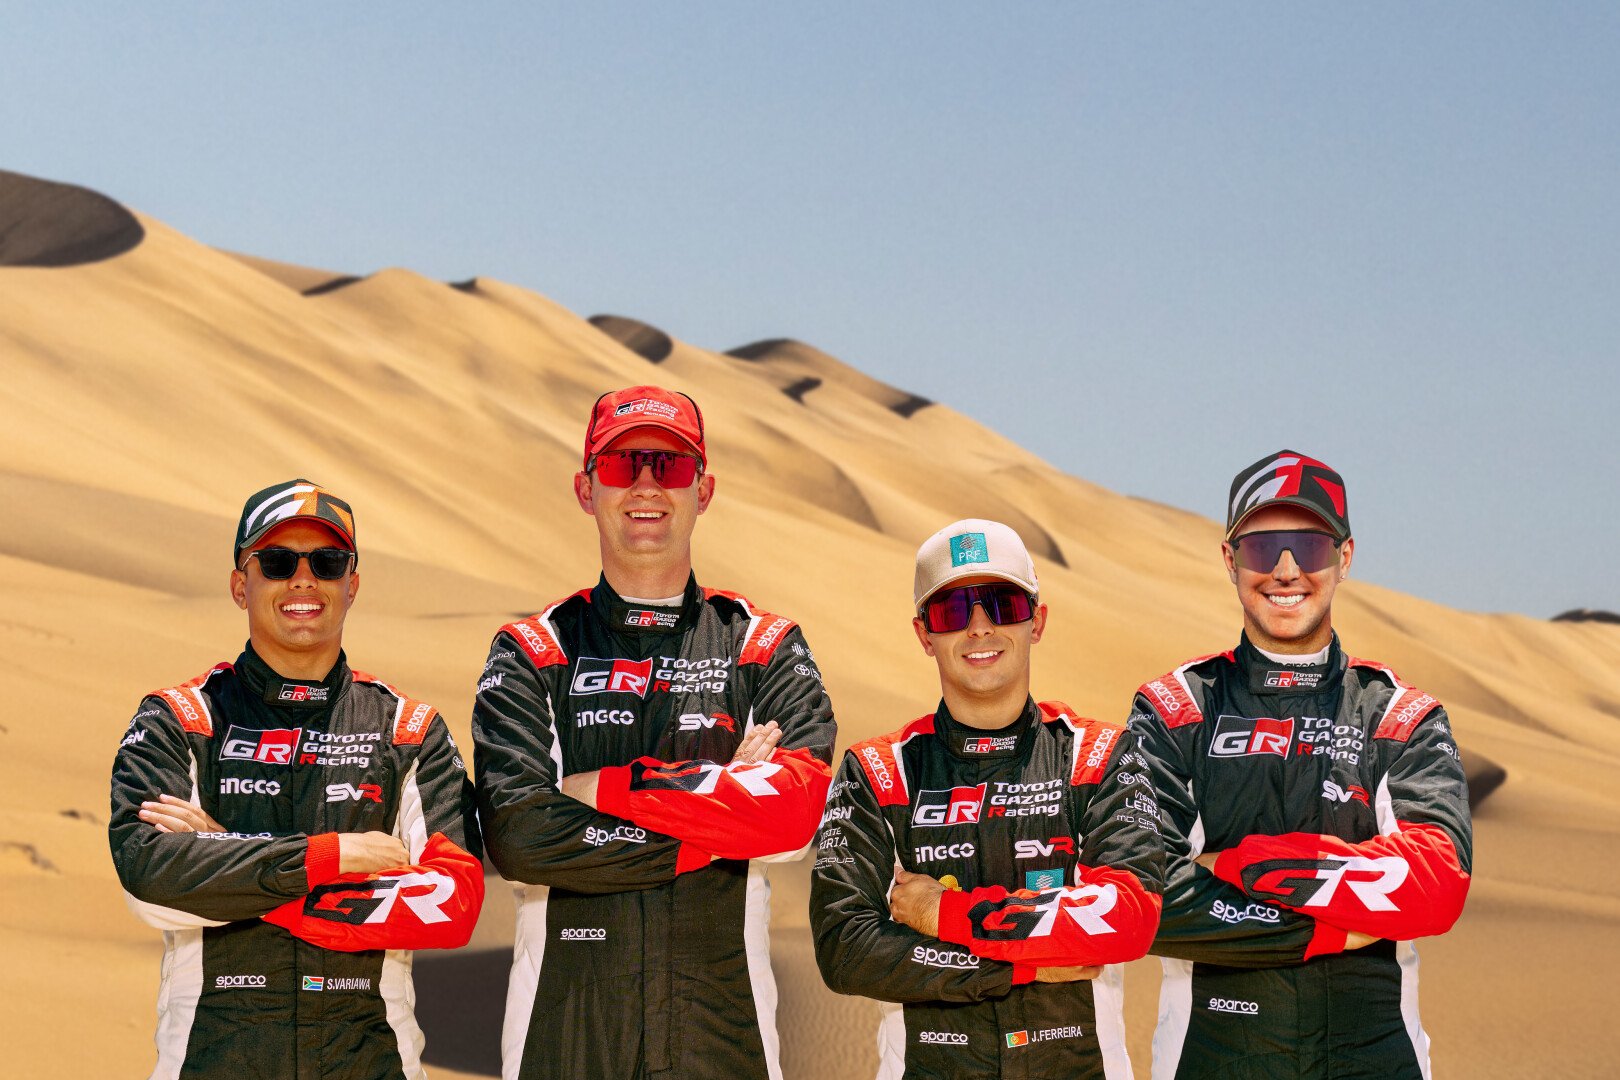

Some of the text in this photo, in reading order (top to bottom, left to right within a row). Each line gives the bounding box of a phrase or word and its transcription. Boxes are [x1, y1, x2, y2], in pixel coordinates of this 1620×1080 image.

[616, 403, 643, 415] GR
[648, 400, 678, 412] TOYOTA
[958, 550, 981, 562] PRF
[628, 616, 651, 625] GR
[652, 620, 675, 628] Racing
[513, 623, 547, 654] sparco
[757, 618, 791, 650] sparco
[659, 655, 732, 669] TOYOTA
[574, 671, 646, 694] GR
[655, 669, 728, 682] GAZOO
[1266, 677, 1291, 686] GR
[280, 690, 305, 700] GR
[653, 681, 726, 694] Racing
[163, 689, 199, 722] sparco
[1146, 681, 1180, 714] sparco
[406, 703, 432, 733] sparco
[1397, 694, 1436, 726] sparco
[679, 712, 736, 733] SVR
[306, 729, 381, 744] TOYOTA
[992, 735, 1018, 743] TOYOTA
[1212, 731, 1290, 754] GR
[223, 739, 291, 762] GR
[302, 742, 374, 754] GAZOO
[965, 742, 989, 752] GR
[1086, 728, 1116, 768] sparco
[300, 753, 369, 768] Racing
[861, 746, 894, 792] sparco
[325, 782, 383, 803] SVR
[993, 778, 1063, 794] TOYOTA
[1321, 779, 1371, 808] SVR
[990, 790, 1062, 806] GAZOO
[824, 806, 853, 822] USN
[914, 800, 981, 825] GR
[987, 803, 1060, 818] Racing
[583, 826, 647, 846] sparco
[1014, 836, 1075, 859] SVR
[1240, 854, 1410, 912] GR
[302, 872, 457, 926] GR
[966, 884, 1118, 941] GR
[1209, 899, 1280, 924] sparco
[560, 928, 607, 940] sparco
[911, 945, 980, 970] sparco
[215, 975, 267, 988] sparco
[326, 977, 371, 990] S.VARIAWA
[1207, 997, 1259, 1015] sparco
[919, 1030, 969, 1045] sparco
[1031, 1025, 1083, 1043] J.FERREIRA
